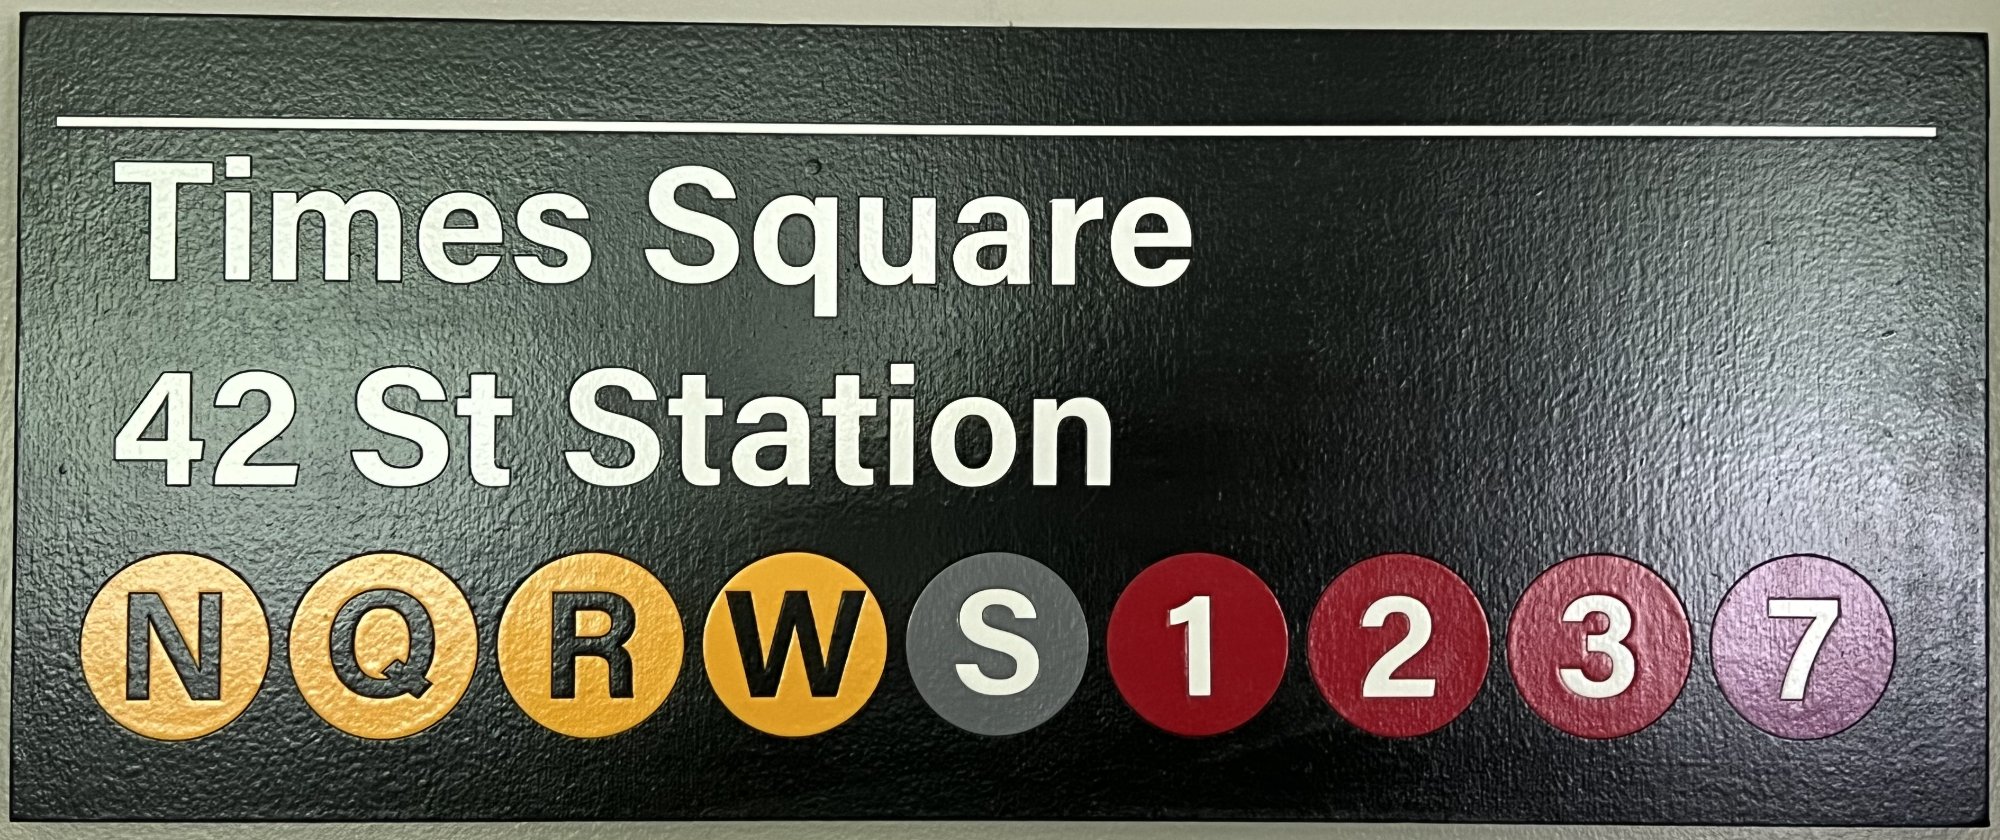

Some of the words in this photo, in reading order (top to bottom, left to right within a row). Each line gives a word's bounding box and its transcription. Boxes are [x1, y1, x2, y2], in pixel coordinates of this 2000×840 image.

[115, 156, 592, 284] Times
[645, 166, 1192, 317] Square
[115, 371, 299, 486] 42
[352, 366, 513, 487] St
[564, 364, 1112, 487] Station
[126, 592, 223, 700] N
[329, 588, 435, 699] Q
[551, 591, 635, 699] R
[725, 591, 866, 697] W
[956, 589, 1039, 695] S
[1169, 596, 1211, 696] 1
[1361, 596, 1436, 698] 2
[1559, 595, 1634, 698] 3
[1768, 598, 1840, 701] 7
